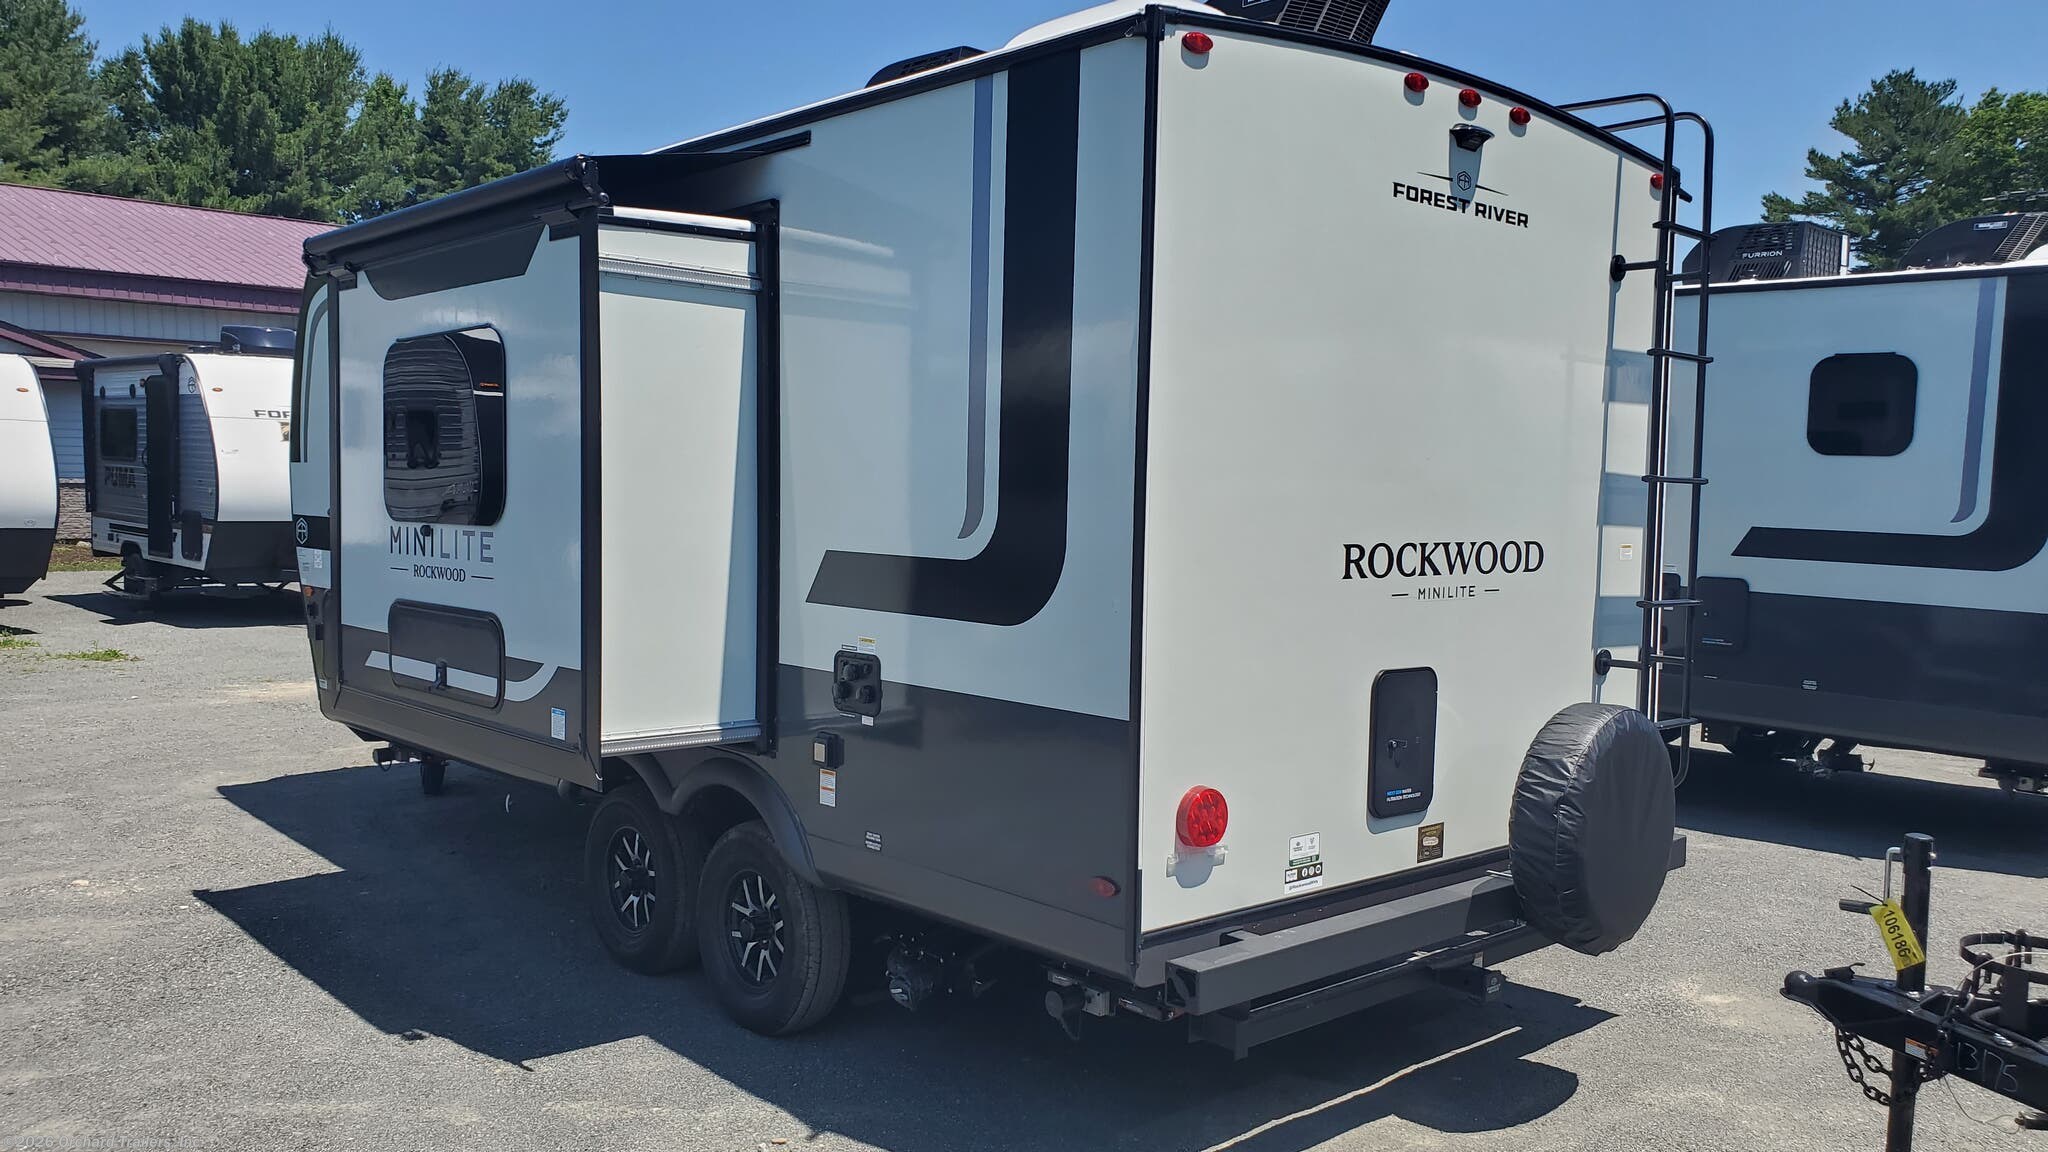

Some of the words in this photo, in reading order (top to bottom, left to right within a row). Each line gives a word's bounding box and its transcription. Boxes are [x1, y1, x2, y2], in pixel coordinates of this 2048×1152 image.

[1392, 181, 1471, 214] FOREST
[1474, 202, 1529, 228] RIVER
[1742, 250, 1783, 259] FURRION
[390, 525, 495, 563] MINILITE
[1341, 540, 1545, 580] ROCKWOOD
[413, 564, 467, 582] ROCKWOOD
[1417, 585, 1476, 600] MINILITE
[1883, 909, 1911, 958] 106186
